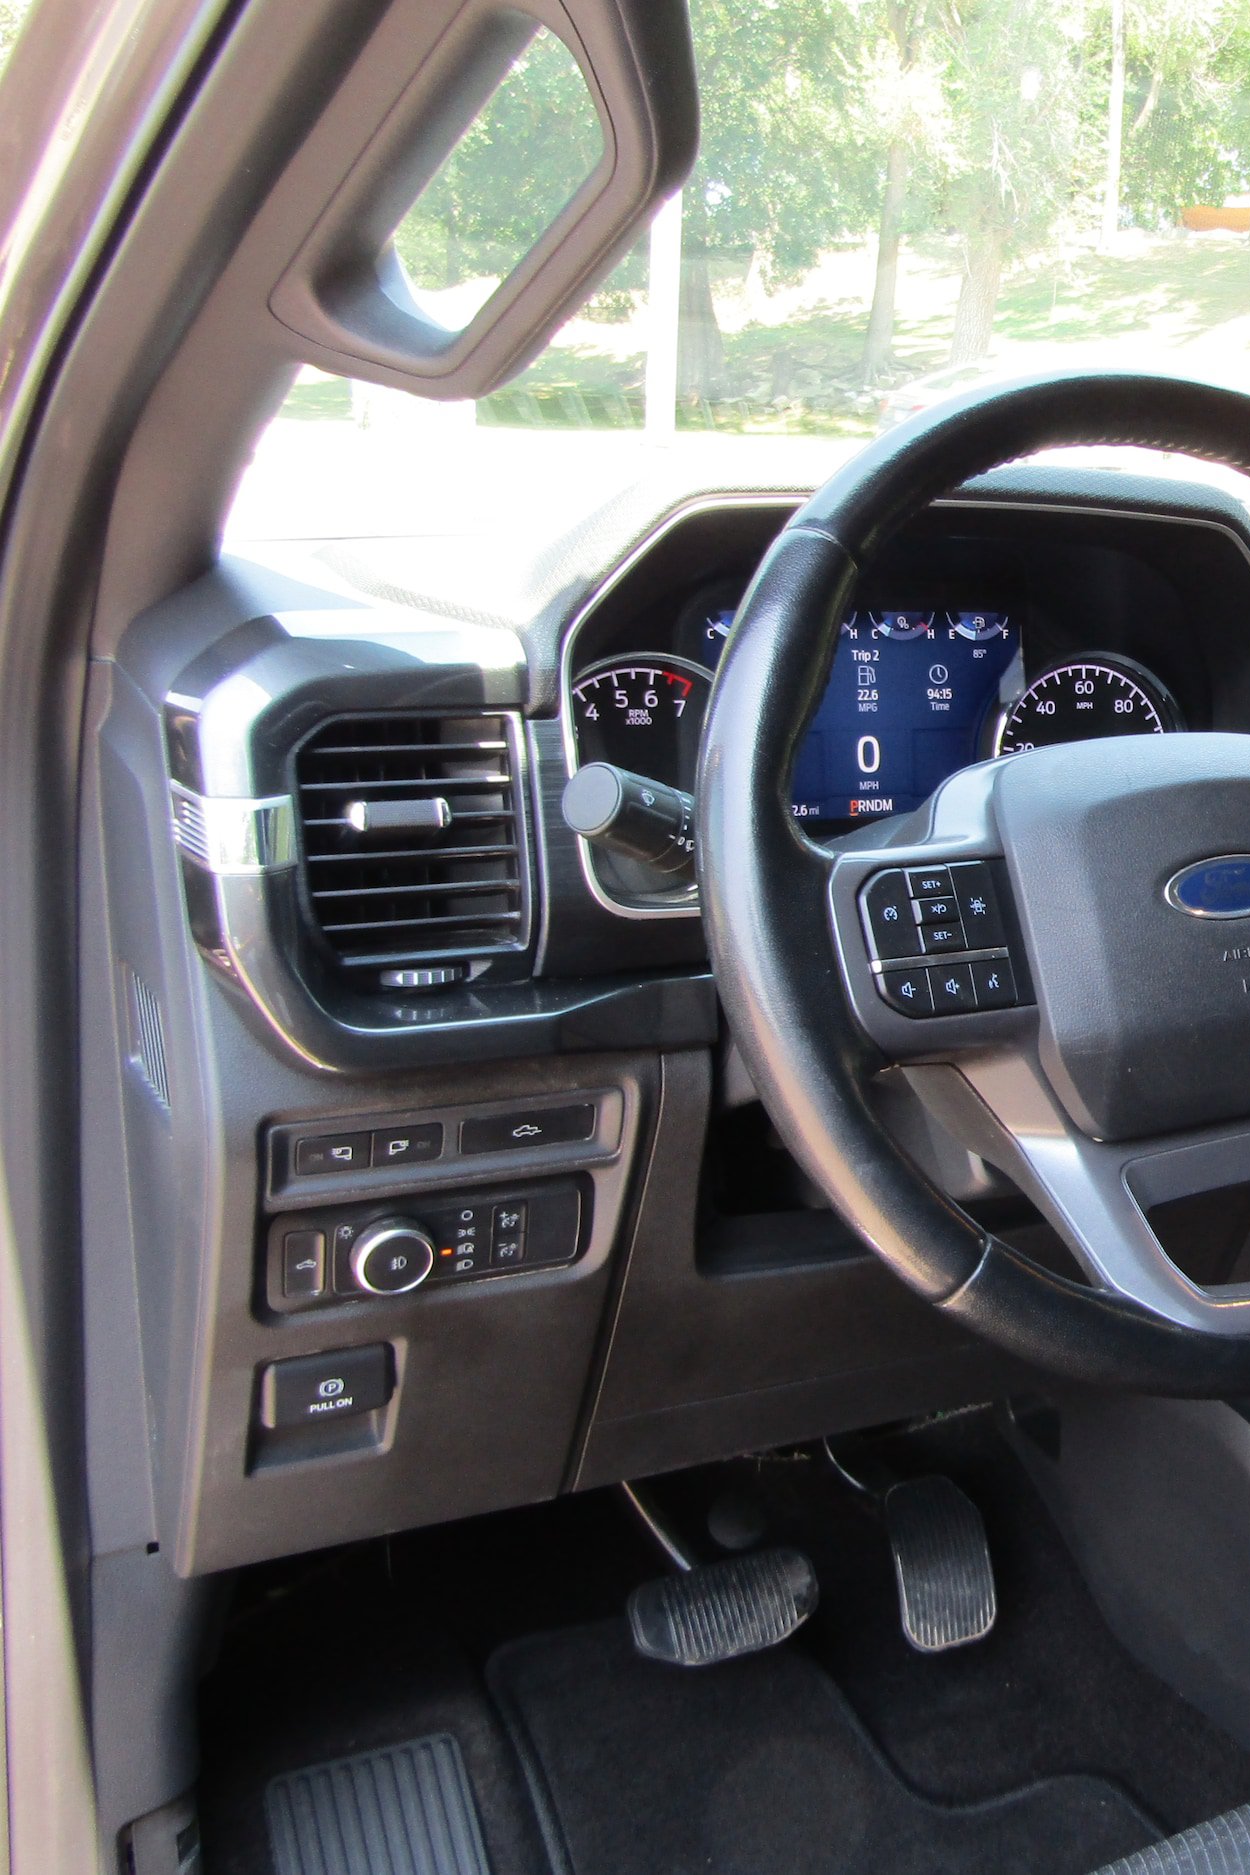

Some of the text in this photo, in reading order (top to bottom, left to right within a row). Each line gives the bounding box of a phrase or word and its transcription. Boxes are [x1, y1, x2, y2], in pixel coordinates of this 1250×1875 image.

[707, 628, 715, 639] C
[850, 629, 858, 639] H
[871, 629, 879, 639] C
[927, 629, 935, 639] H
[949, 629, 955, 639] E
[1002, 629, 1009, 639] F
[851, 650, 880, 662] Trip 2
[1075, 681, 1094, 694] 60
[615, 690, 628, 708] 5
[644, 690, 658, 707] 6
[857, 689, 879, 701] 22.6
[926, 688, 952, 699] 94:15
[673, 700, 686, 717] 7
[858, 703, 878, 712] MPG
[930, 701, 950, 711] Time
[1036, 701, 1056, 715] 40
[1076, 702, 1093, 710] MPH
[1114, 699, 1134, 713] 80
[585, 703, 600, 721] 4
[628, 709, 649, 717] RPM
[625, 717, 653, 725] x1000
[857, 735, 880, 773] 0
[859, 781, 879, 790] MPH
[808, 805, 820, 815] mi
[850, 799, 893, 815] PRNDM
[328, 1383, 337, 1393] P
[310, 1396, 353, 1413] PULL ON
